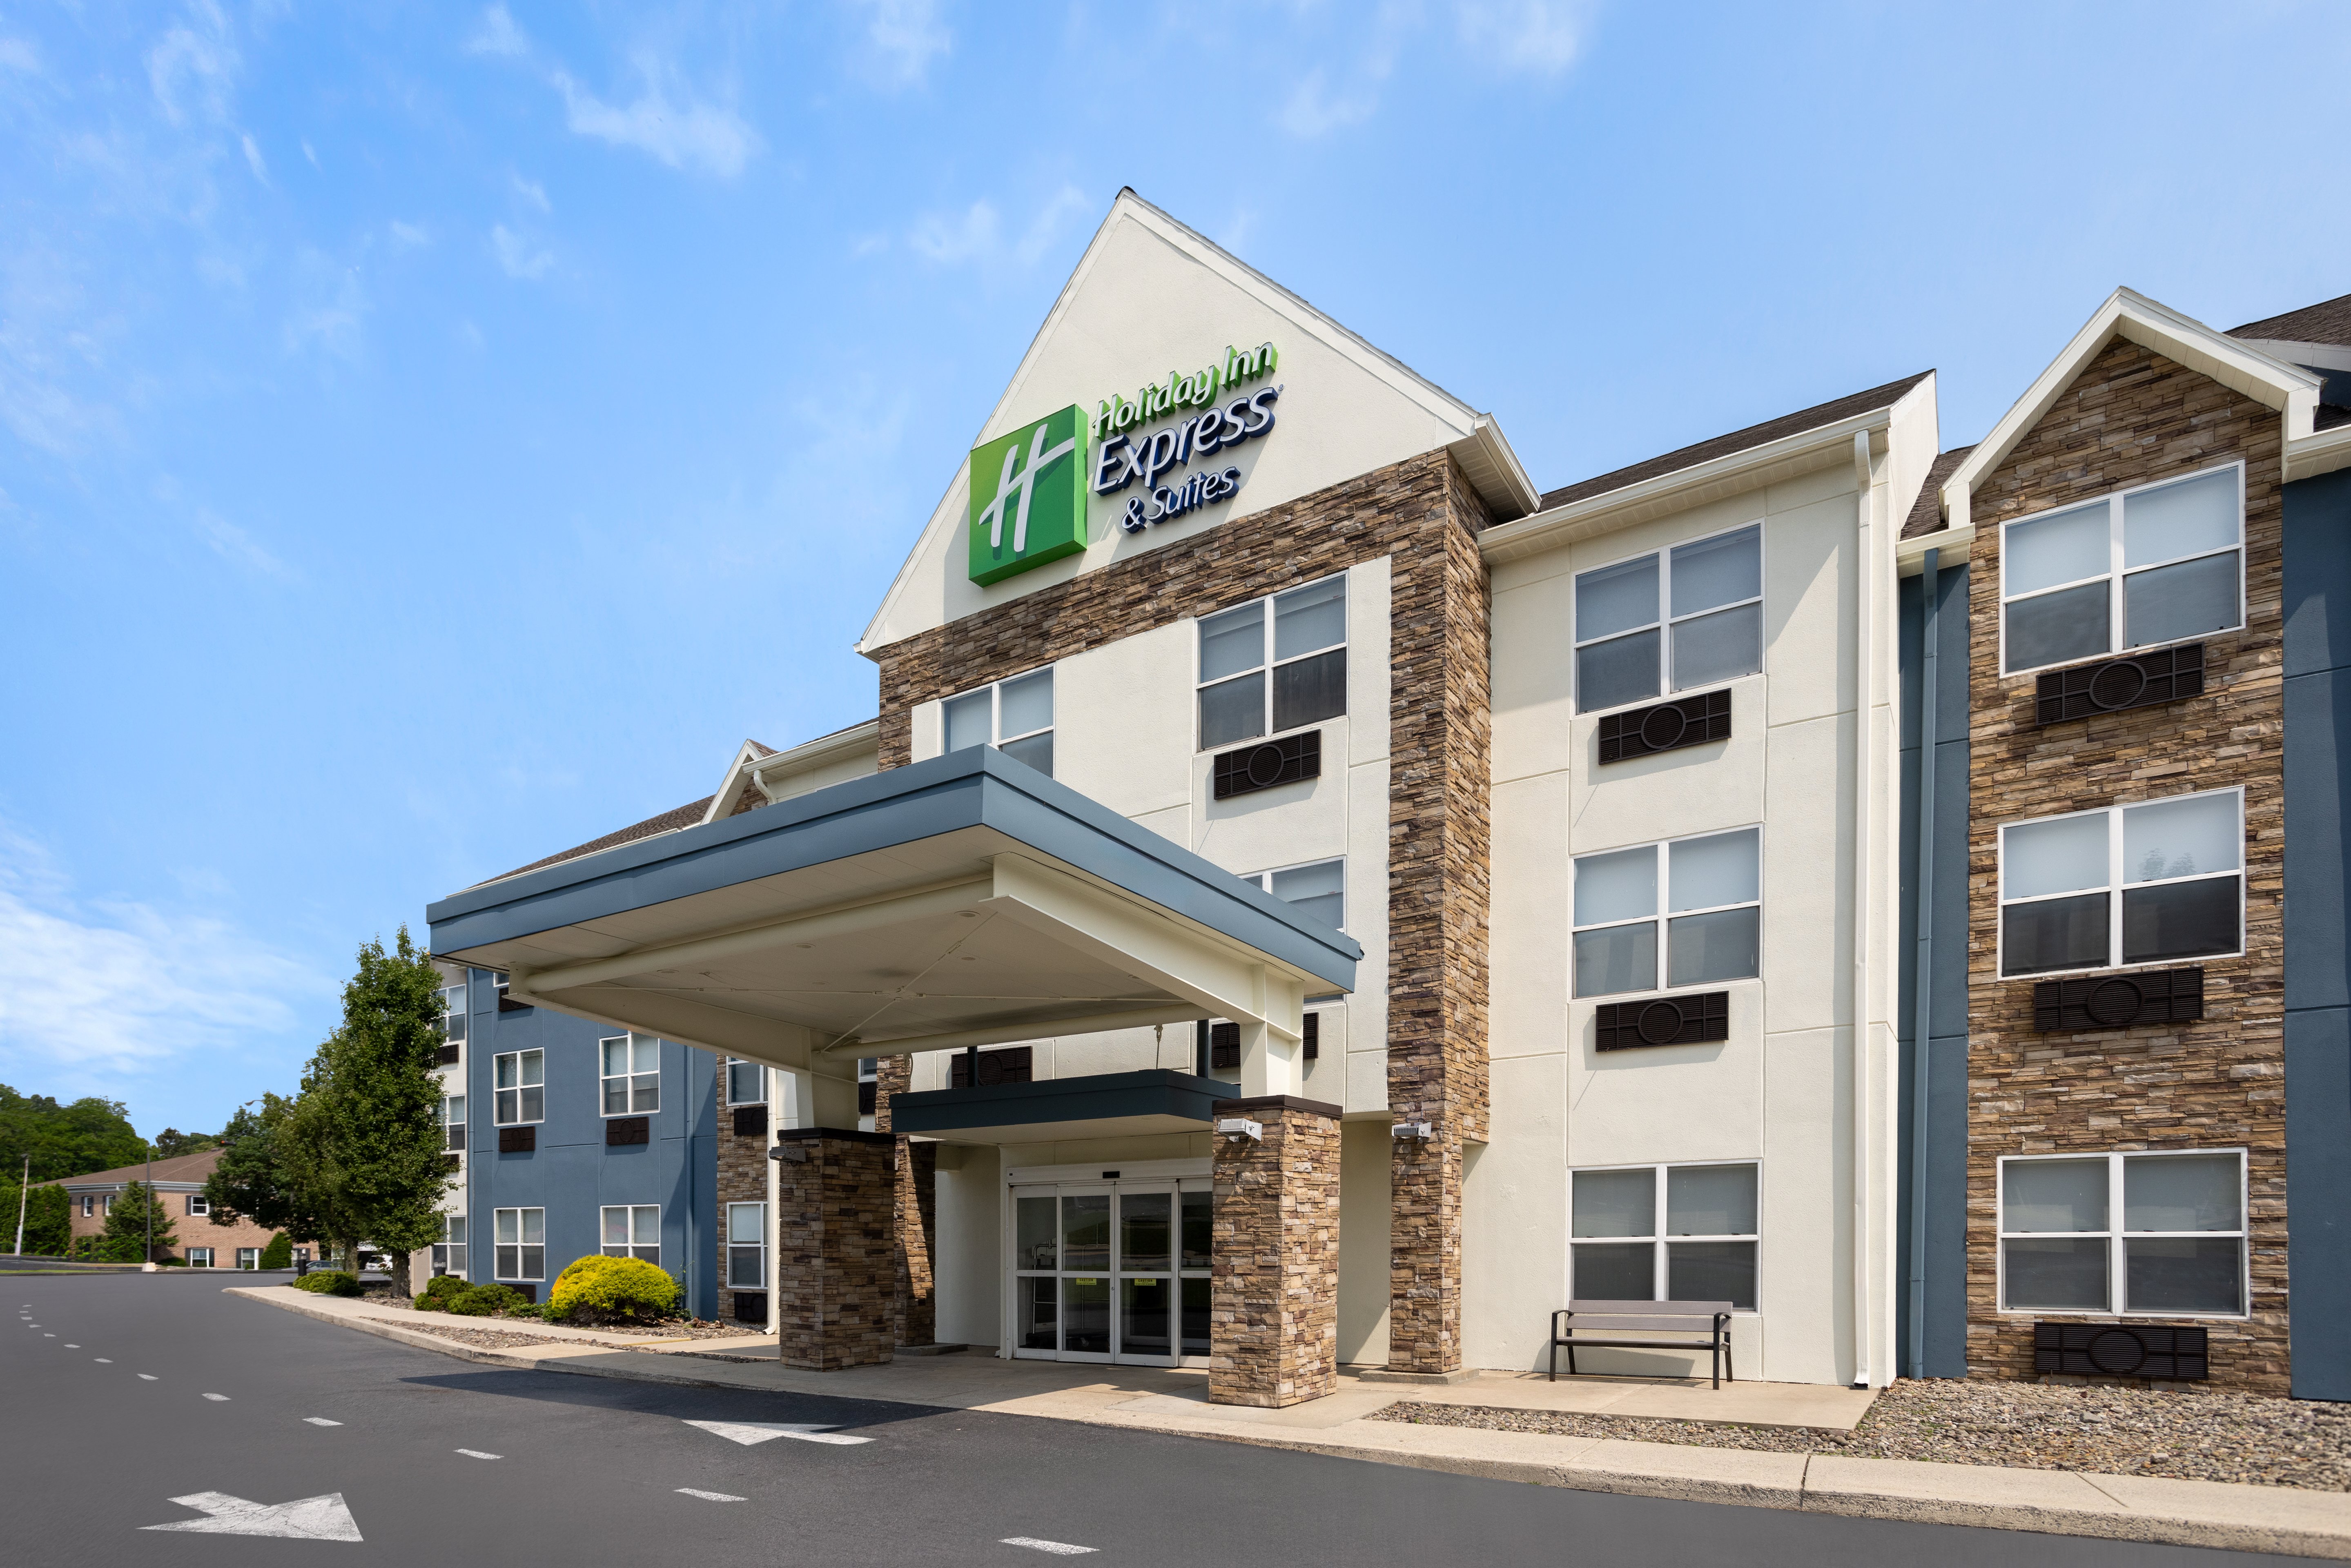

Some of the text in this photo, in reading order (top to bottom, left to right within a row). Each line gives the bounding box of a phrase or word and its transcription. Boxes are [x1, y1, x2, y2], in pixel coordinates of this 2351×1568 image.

[1092, 342, 1278, 441] Holiday Inn
[1093, 387, 1279, 496] Express
[1121, 467, 1241, 534] & Suites
